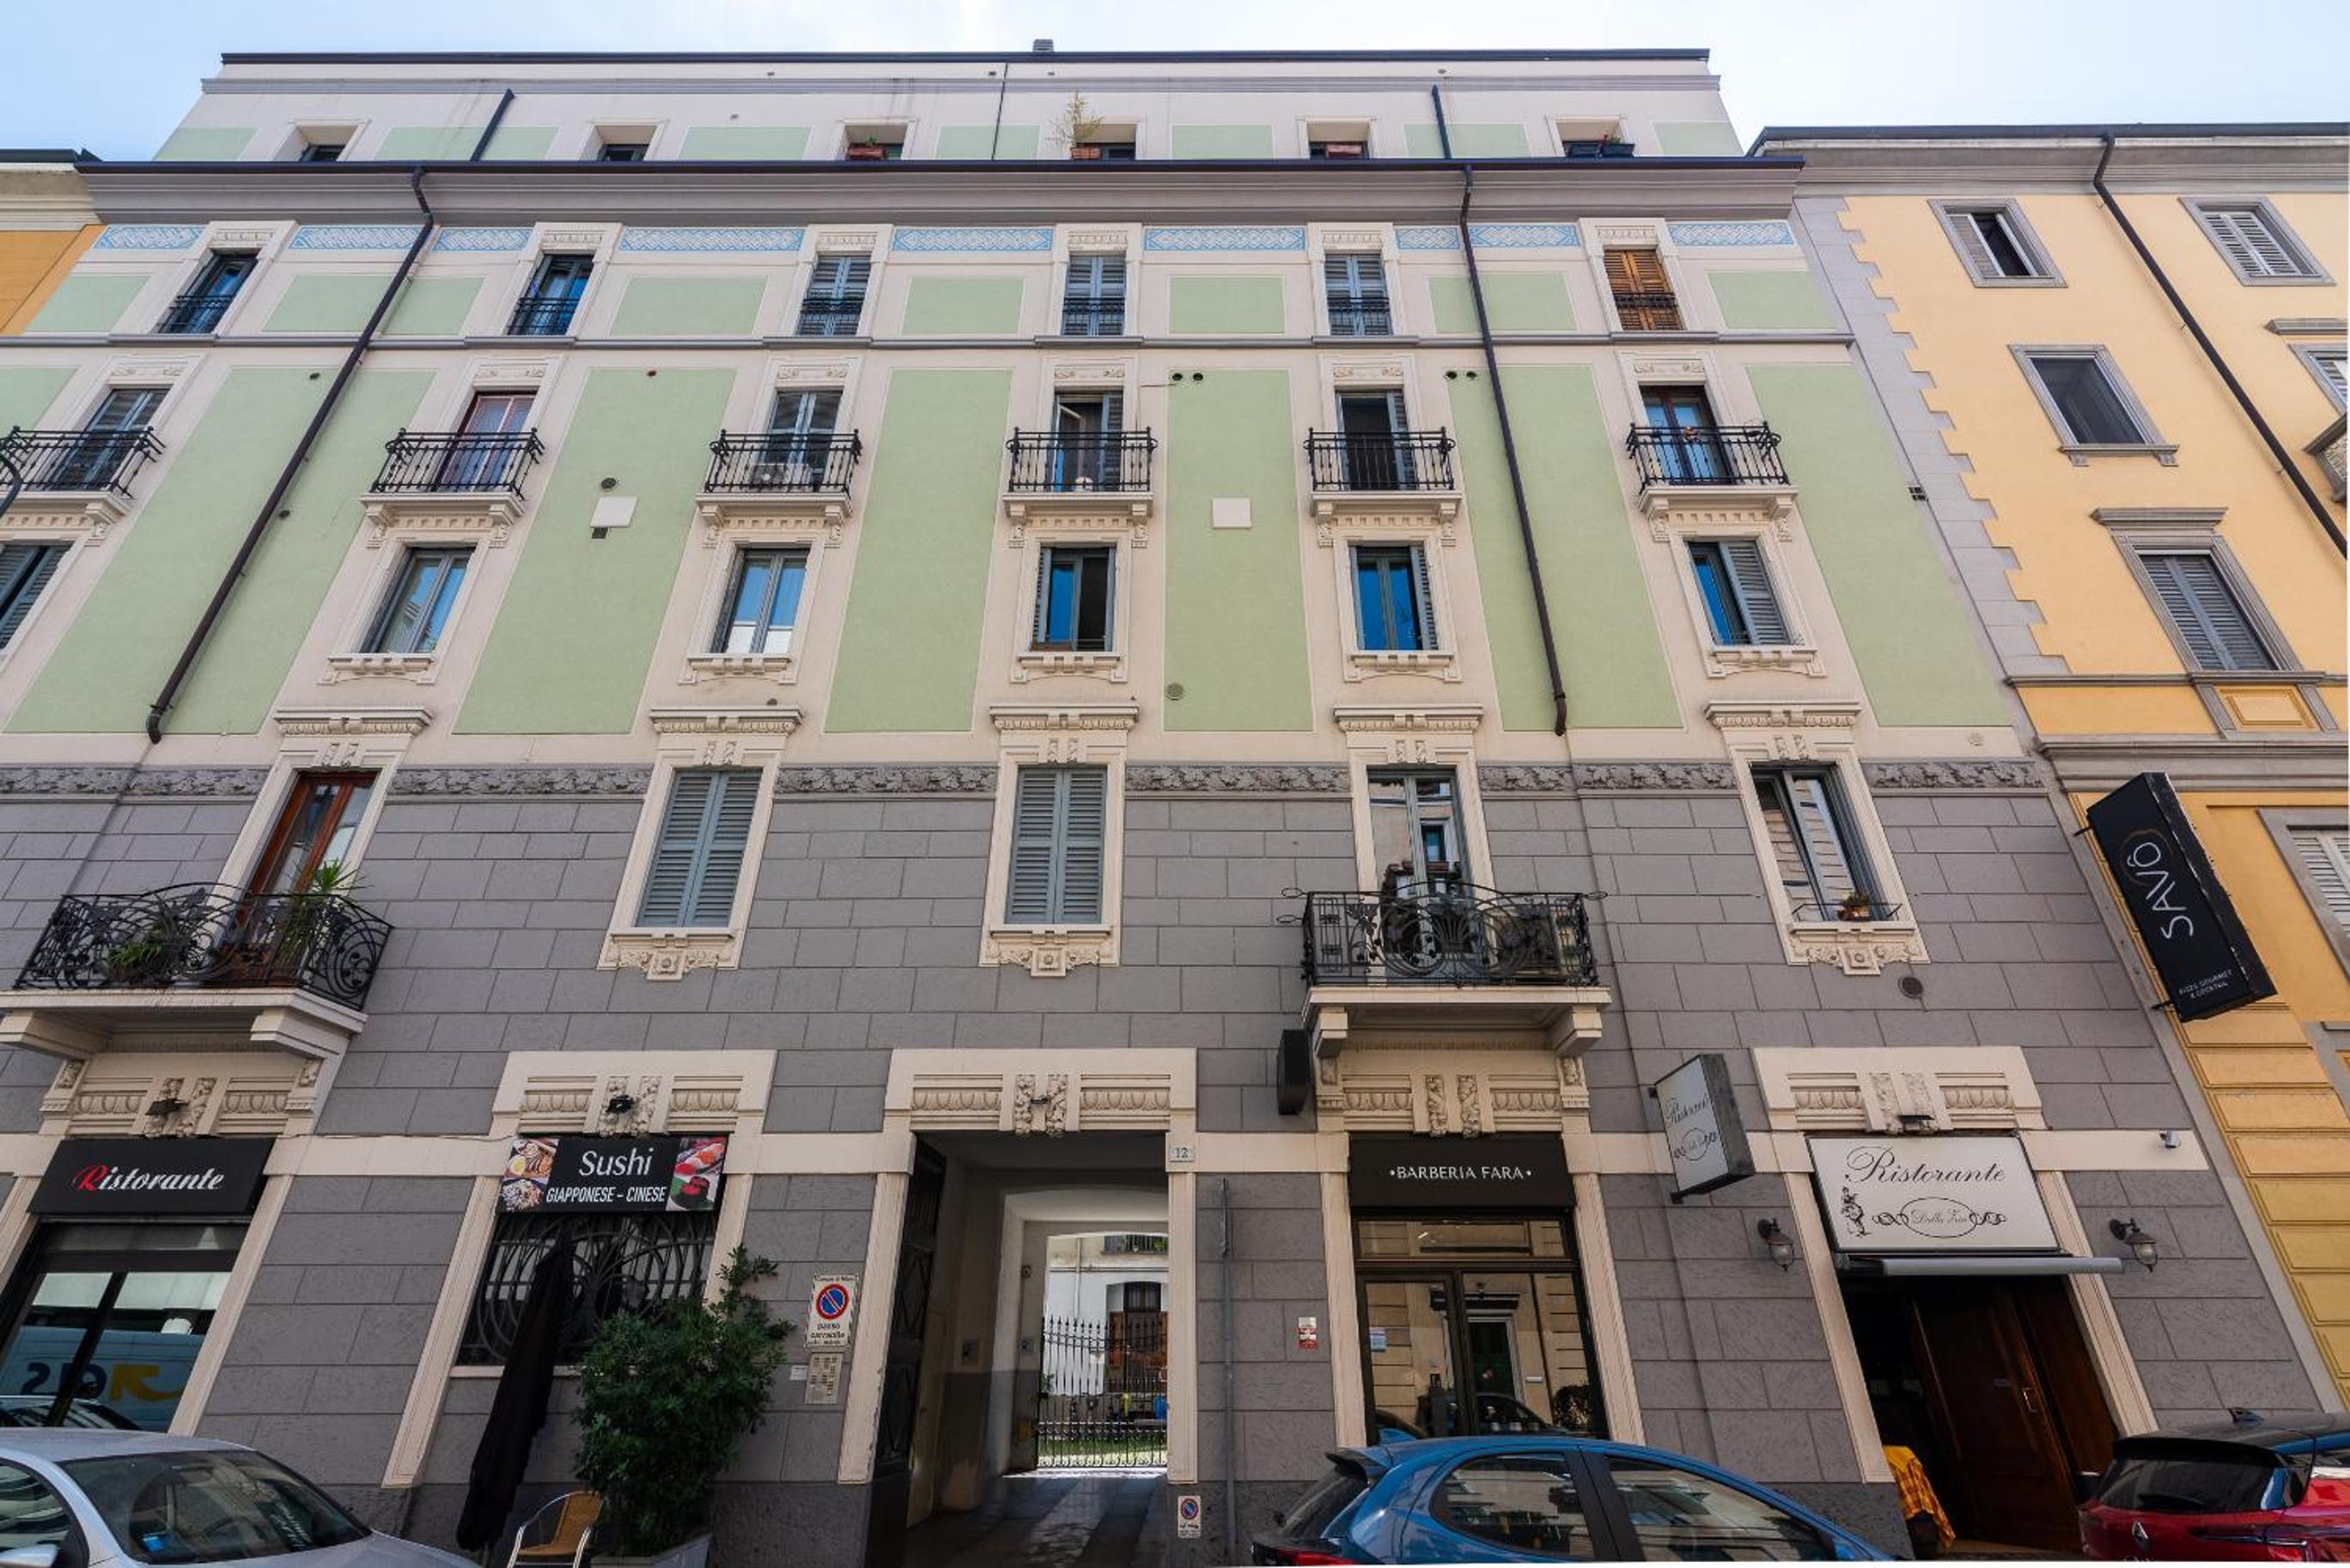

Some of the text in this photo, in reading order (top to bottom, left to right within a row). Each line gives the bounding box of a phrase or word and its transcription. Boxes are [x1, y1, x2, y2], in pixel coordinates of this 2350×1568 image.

[579, 1147, 654, 1176] Sushi
[1176, 1147, 1189, 1158] 12
[1482, 1166, 1524, 1180] FARA
[1845, 1146, 2006, 1182] Ristorante
[71, 1164, 225, 1191] Ristorante
[545, 1186, 614, 1202] GIAPPONESE
[626, 1186, 667, 1202] CINESE
